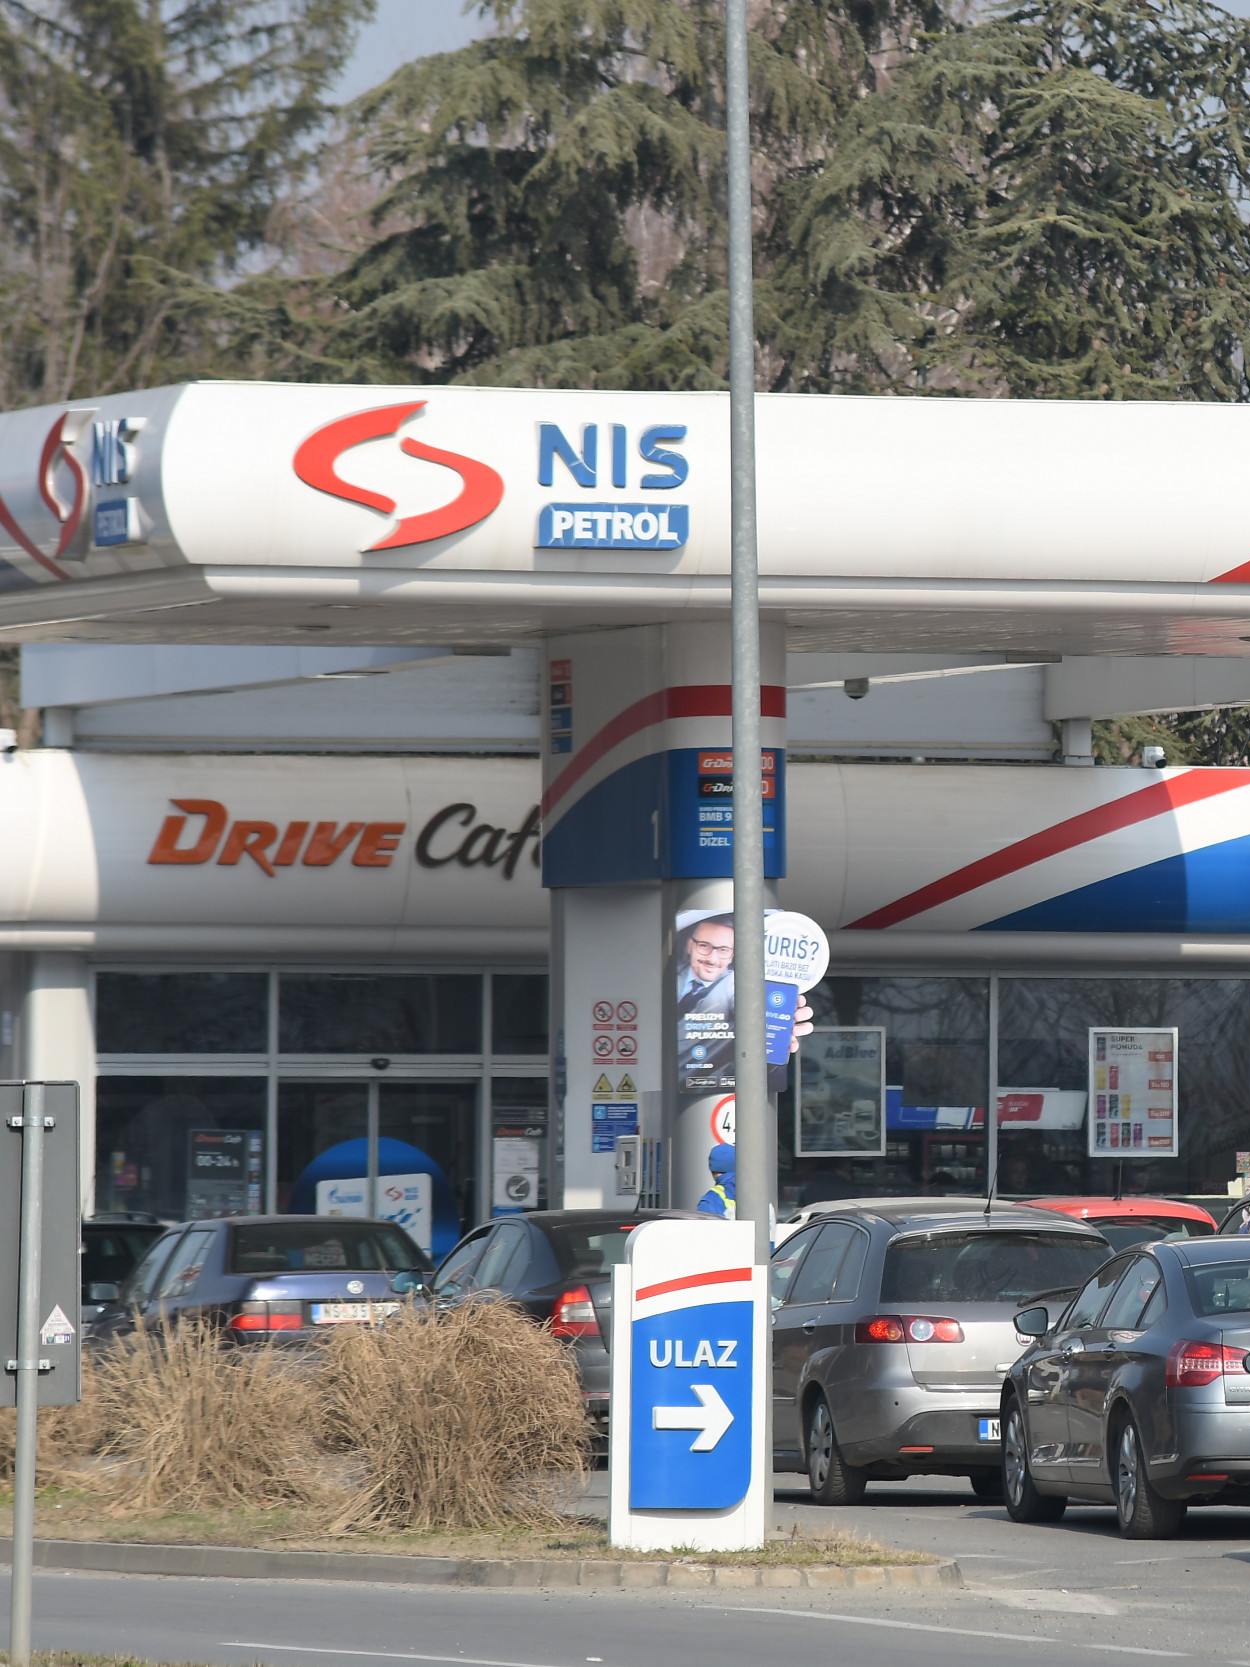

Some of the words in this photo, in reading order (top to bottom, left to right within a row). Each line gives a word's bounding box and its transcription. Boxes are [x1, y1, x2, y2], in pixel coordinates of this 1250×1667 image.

[538, 423, 689, 489] NIS
[553, 511, 678, 541] PETROL
[700, 812, 723, 821] BMB
[415, 803, 541, 880] Caf
[651, 810, 659, 859] 1
[700, 837, 730, 847] DIZEL
[764, 934, 819, 961] URIŠ?
[824, 1044, 877, 1059] AdBlue
[1111, 1035, 1135, 1043] SUPER
[1111, 1043, 1144, 1051] PONUDA
[649, 1339, 739, 1369] ULAZ
